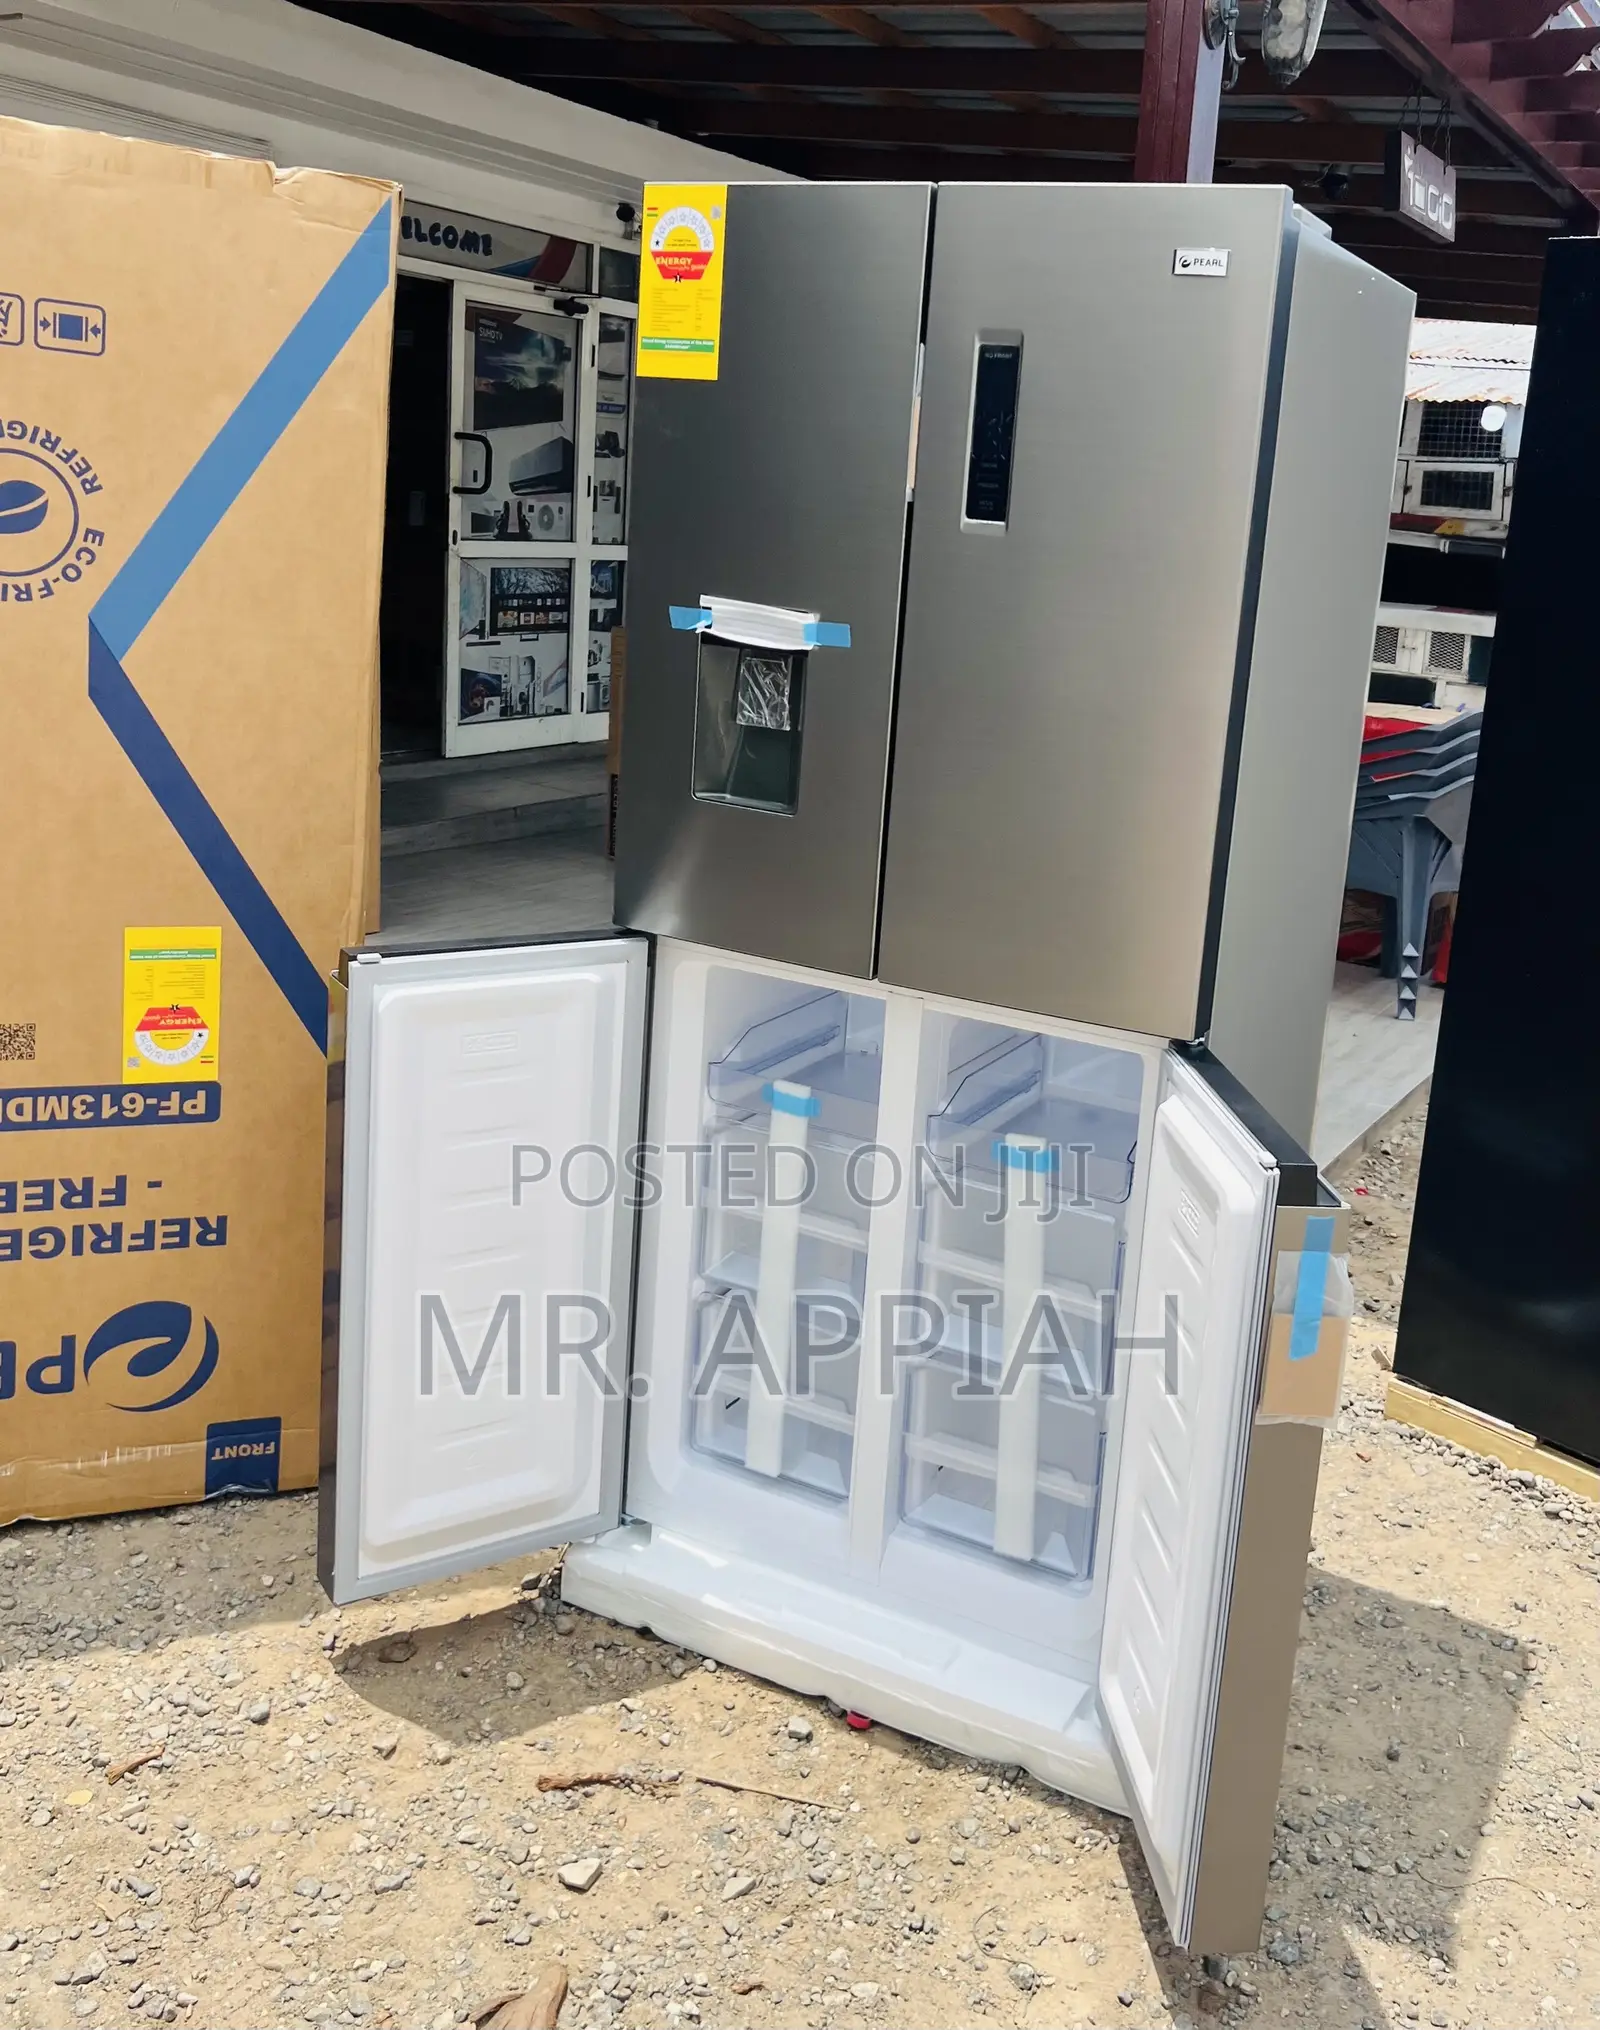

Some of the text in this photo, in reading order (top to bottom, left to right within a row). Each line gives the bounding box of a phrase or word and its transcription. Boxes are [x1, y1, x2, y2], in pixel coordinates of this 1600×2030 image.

[655, 256, 692, 266] ENERGY
[1193, 257, 1224, 267] PEARL
[0, 418, 103, 495] REFRIG
[159, 1016, 202, 1026] ENERGY
[0, 1089, 207, 1123] PF-613MD
[211, 1441, 276, 1461] FRONT
